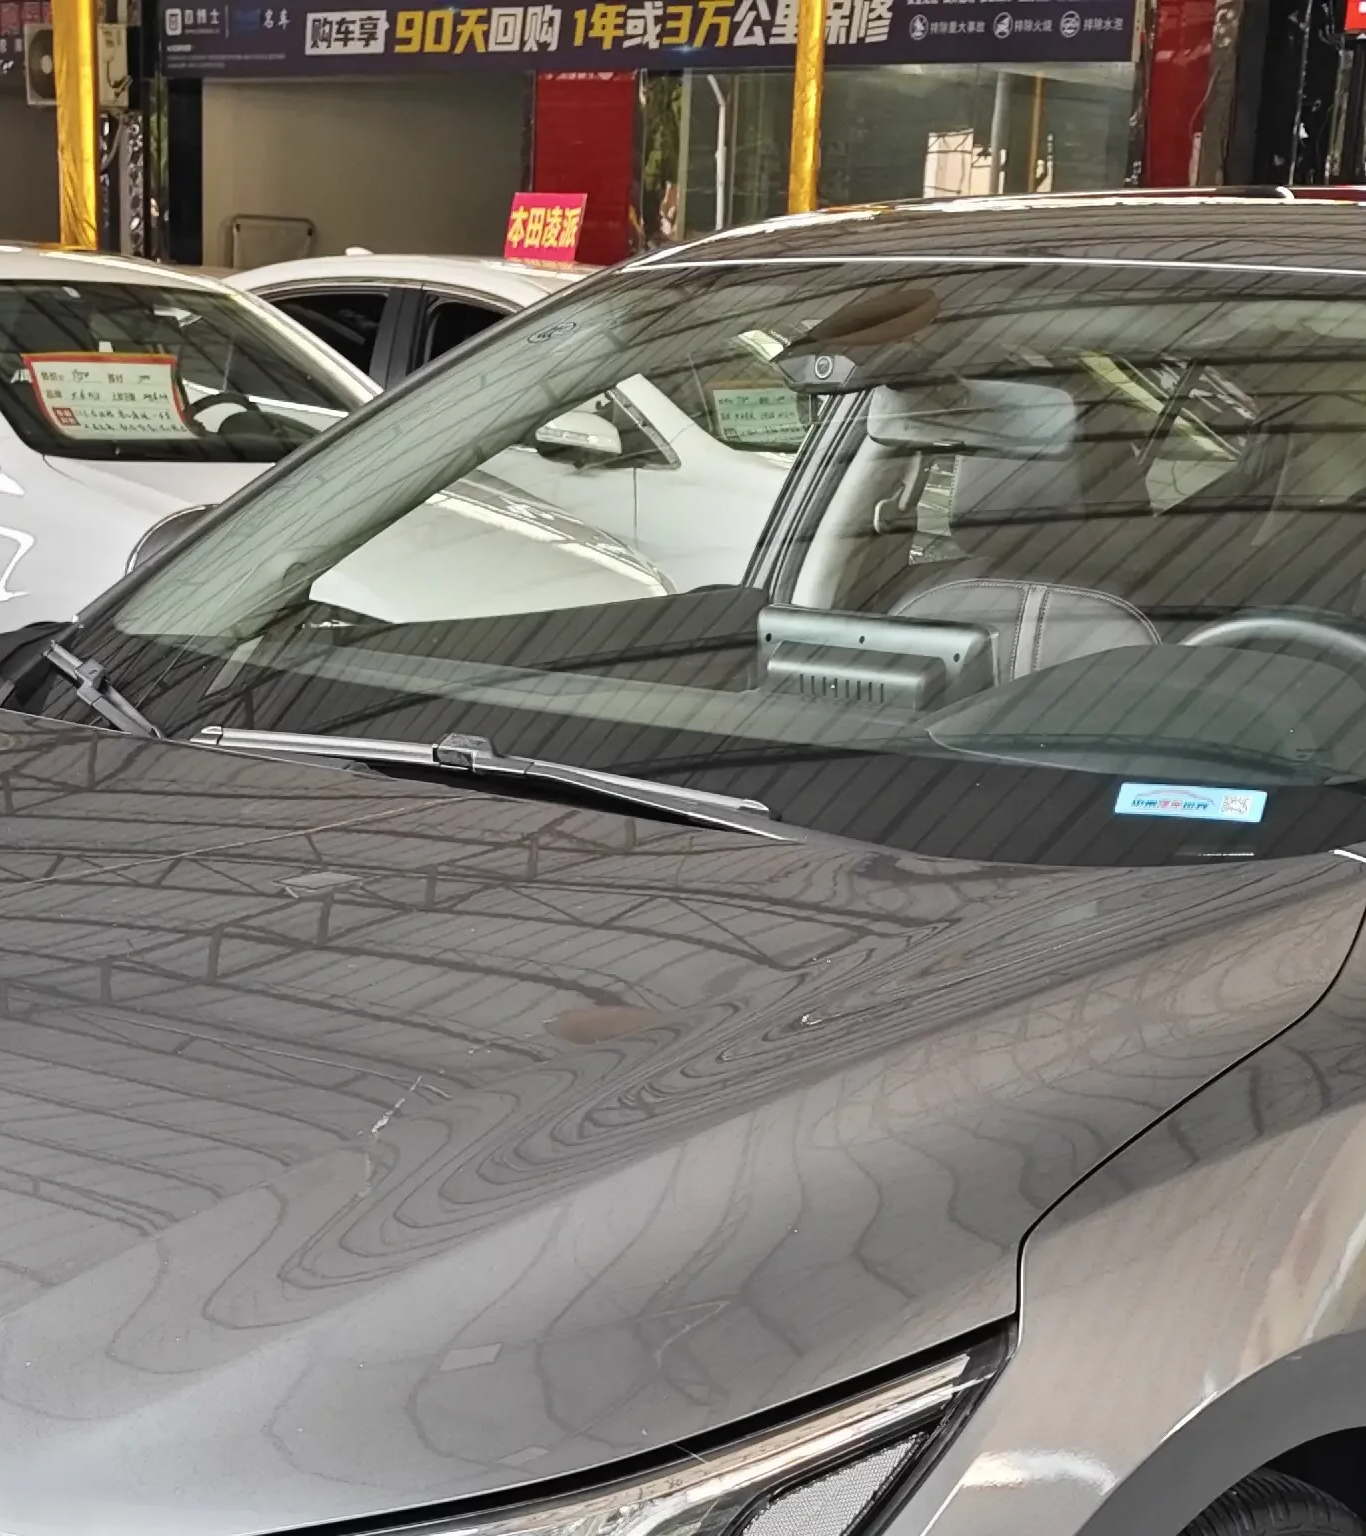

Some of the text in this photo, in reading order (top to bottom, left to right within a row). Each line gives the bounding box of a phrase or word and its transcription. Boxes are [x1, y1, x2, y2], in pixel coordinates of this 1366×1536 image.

[310, 16, 381, 49] 购车享
[394, 5, 563, 54] 90天回购
[573, 0, 894, 50] 1年或3万公里保修
[507, 205, 583, 249] 本田凌派
